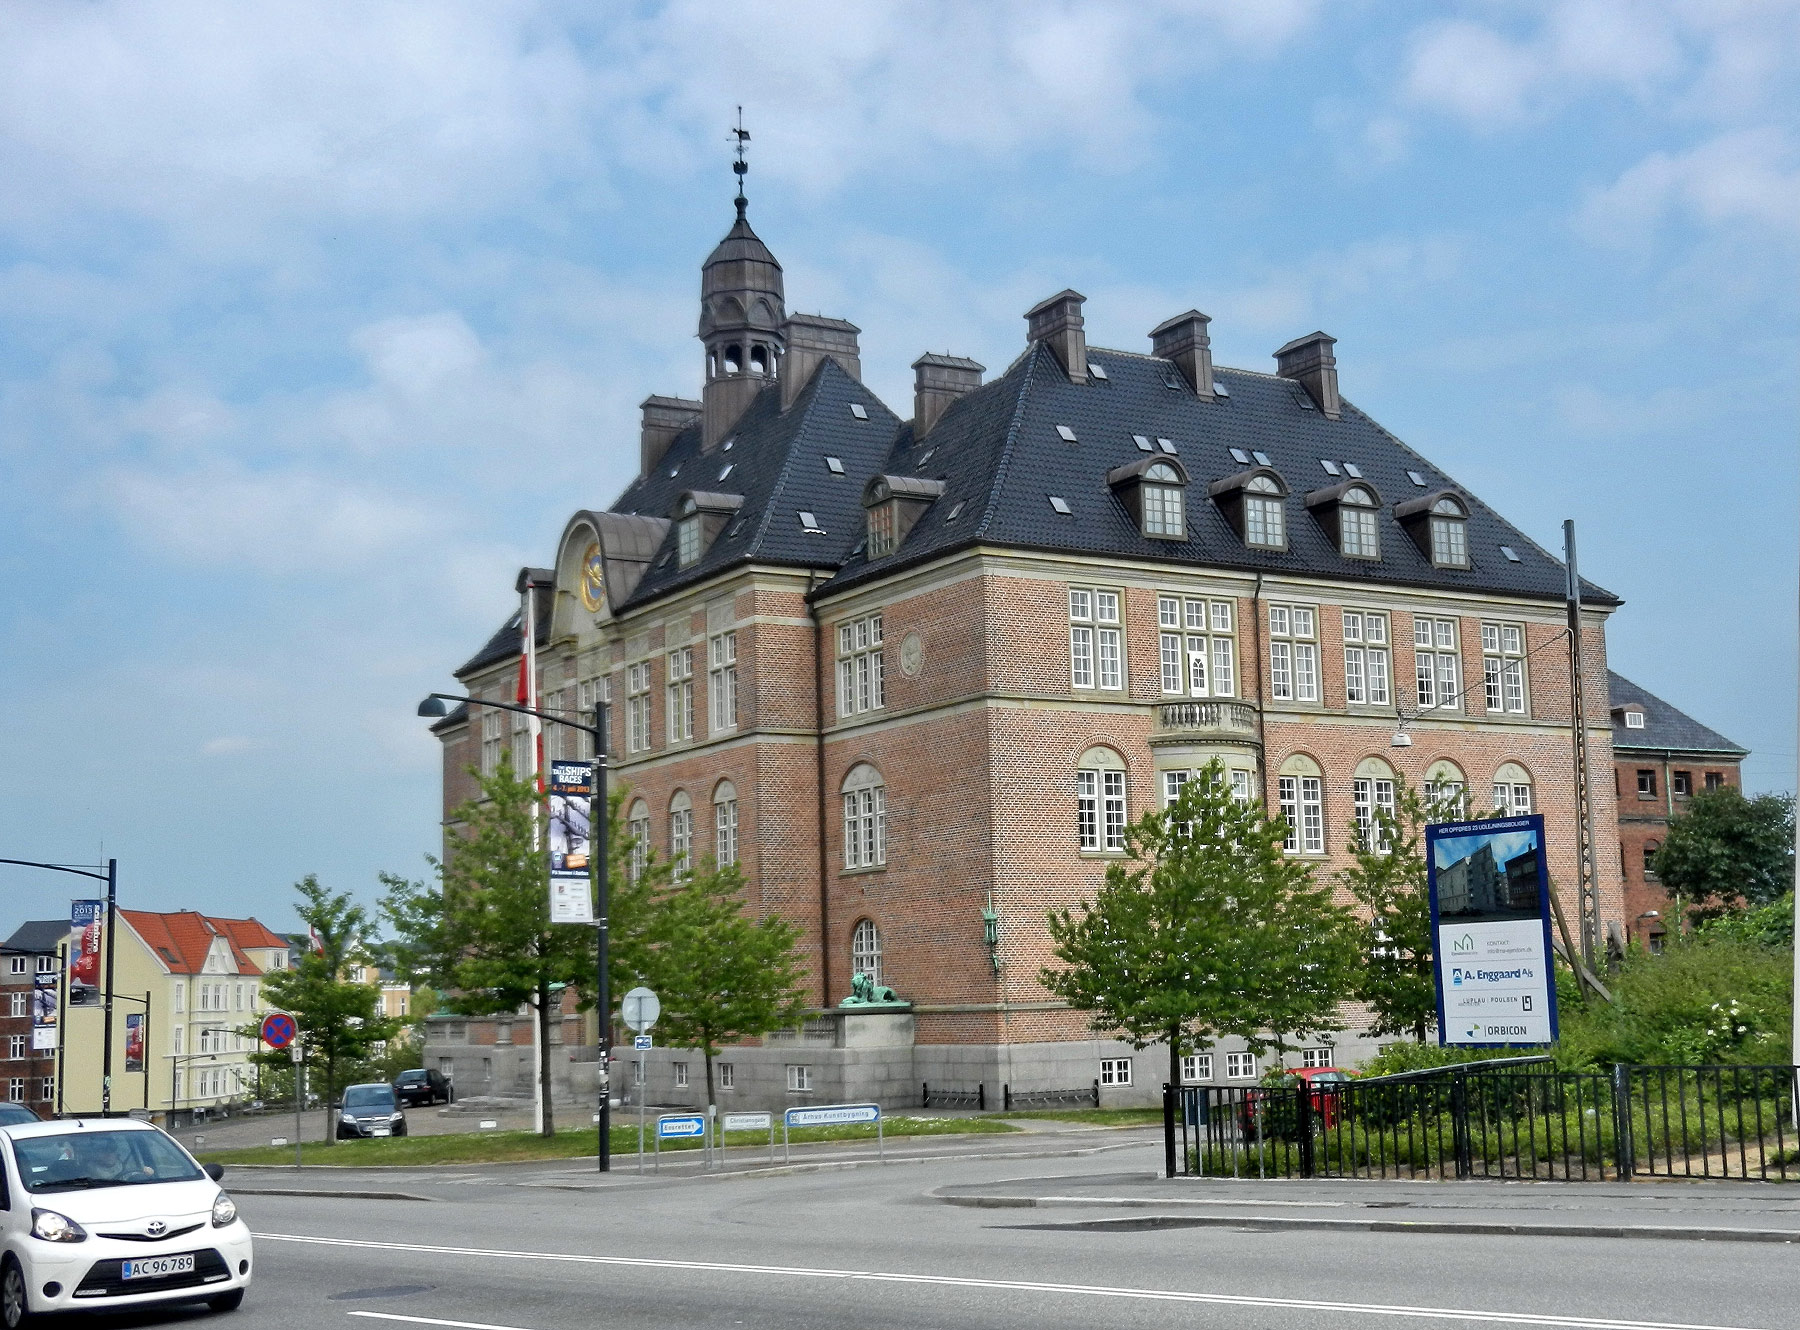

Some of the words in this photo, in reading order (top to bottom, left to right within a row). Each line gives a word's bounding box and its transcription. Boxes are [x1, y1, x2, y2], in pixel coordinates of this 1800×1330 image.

[565, 766, 592, 777] SHIPS
[558, 774, 583, 784] RACES
[92, 904, 101, 953] sculpture
[1464, 970, 1475, 980] A.
[1476, 969, 1521, 982] Enggaard
[1487, 1025, 1527, 1036] ORBICON
[824, 1110, 869, 1119] Kunstbygning
[132, 1261, 149, 1275] AC
[152, 1260, 168, 1273] 96
[170, 1257, 193, 1271] 789
